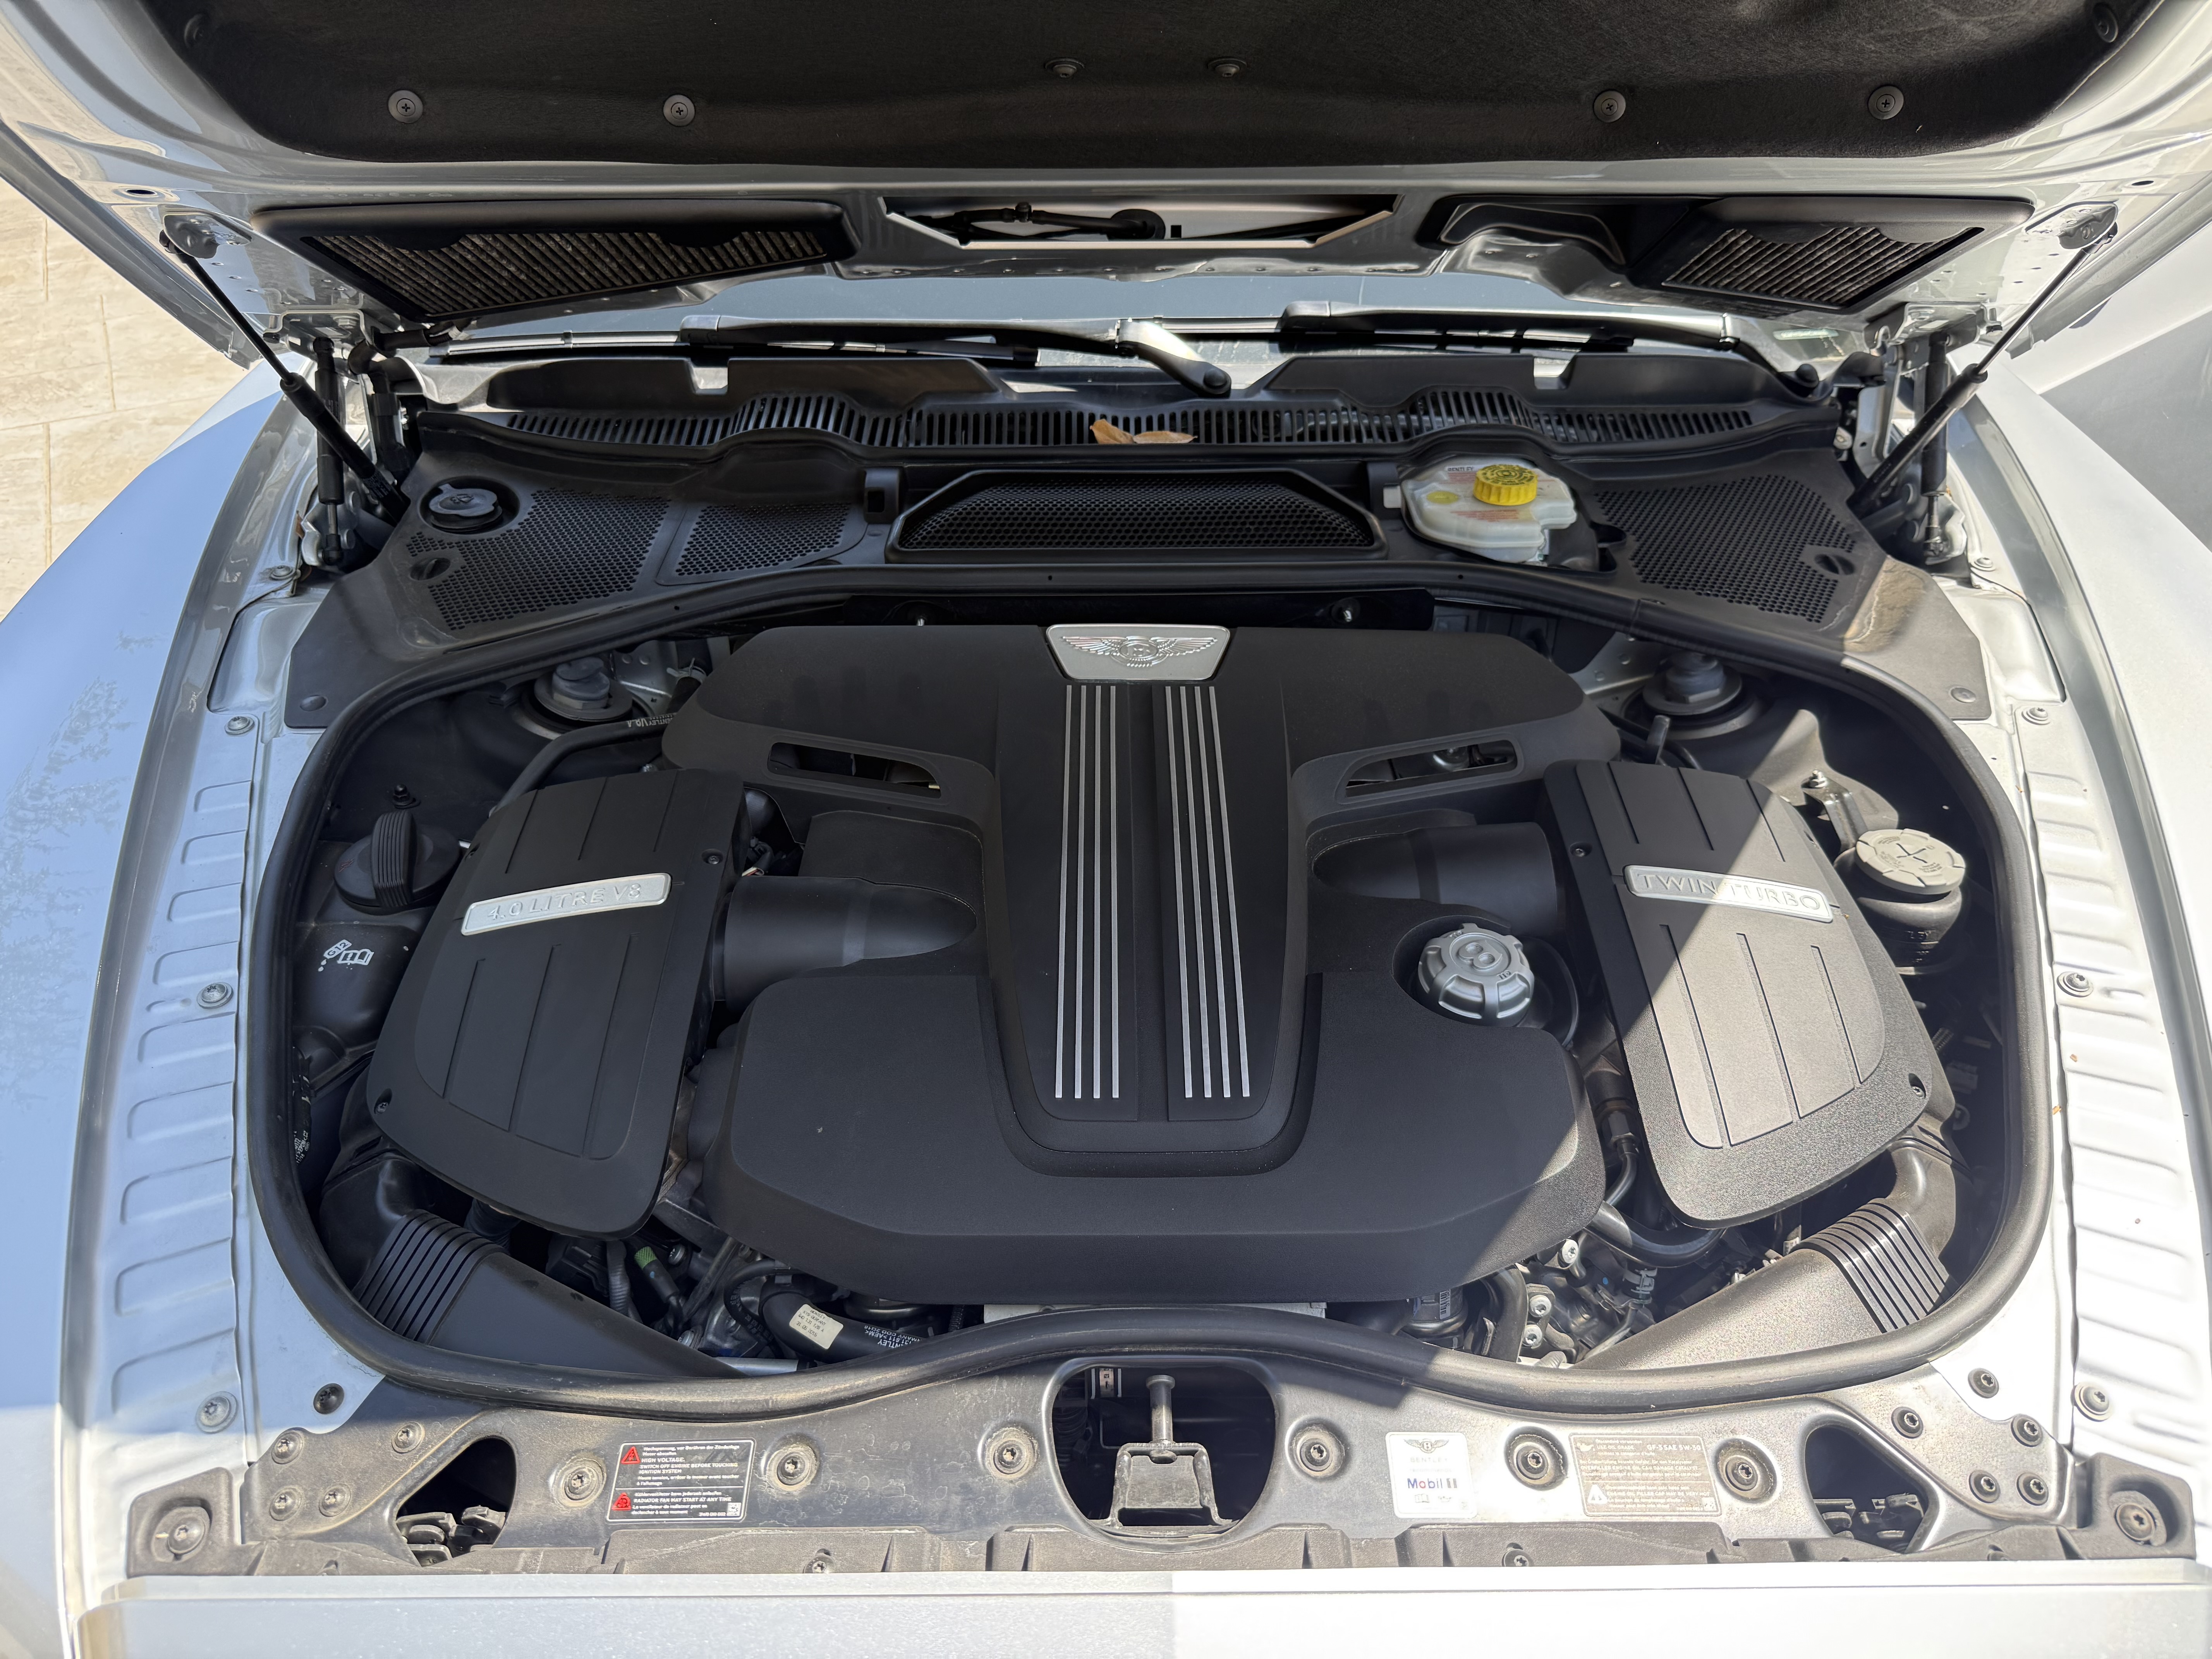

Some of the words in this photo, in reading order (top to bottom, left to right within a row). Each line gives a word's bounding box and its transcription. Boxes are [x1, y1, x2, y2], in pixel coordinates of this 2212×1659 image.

[649, 718, 673, 726] ENTLEY
[1638, 874, 1719, 895] TWIN
[1724, 883, 1820, 910] TURBO
[487, 901, 523, 920] 4.0
[529, 888, 605, 913] LITRE
[613, 884, 641, 900] V8
[327, 942, 349, 956] G12
[1407, 1478, 1443, 1489] Mobil
